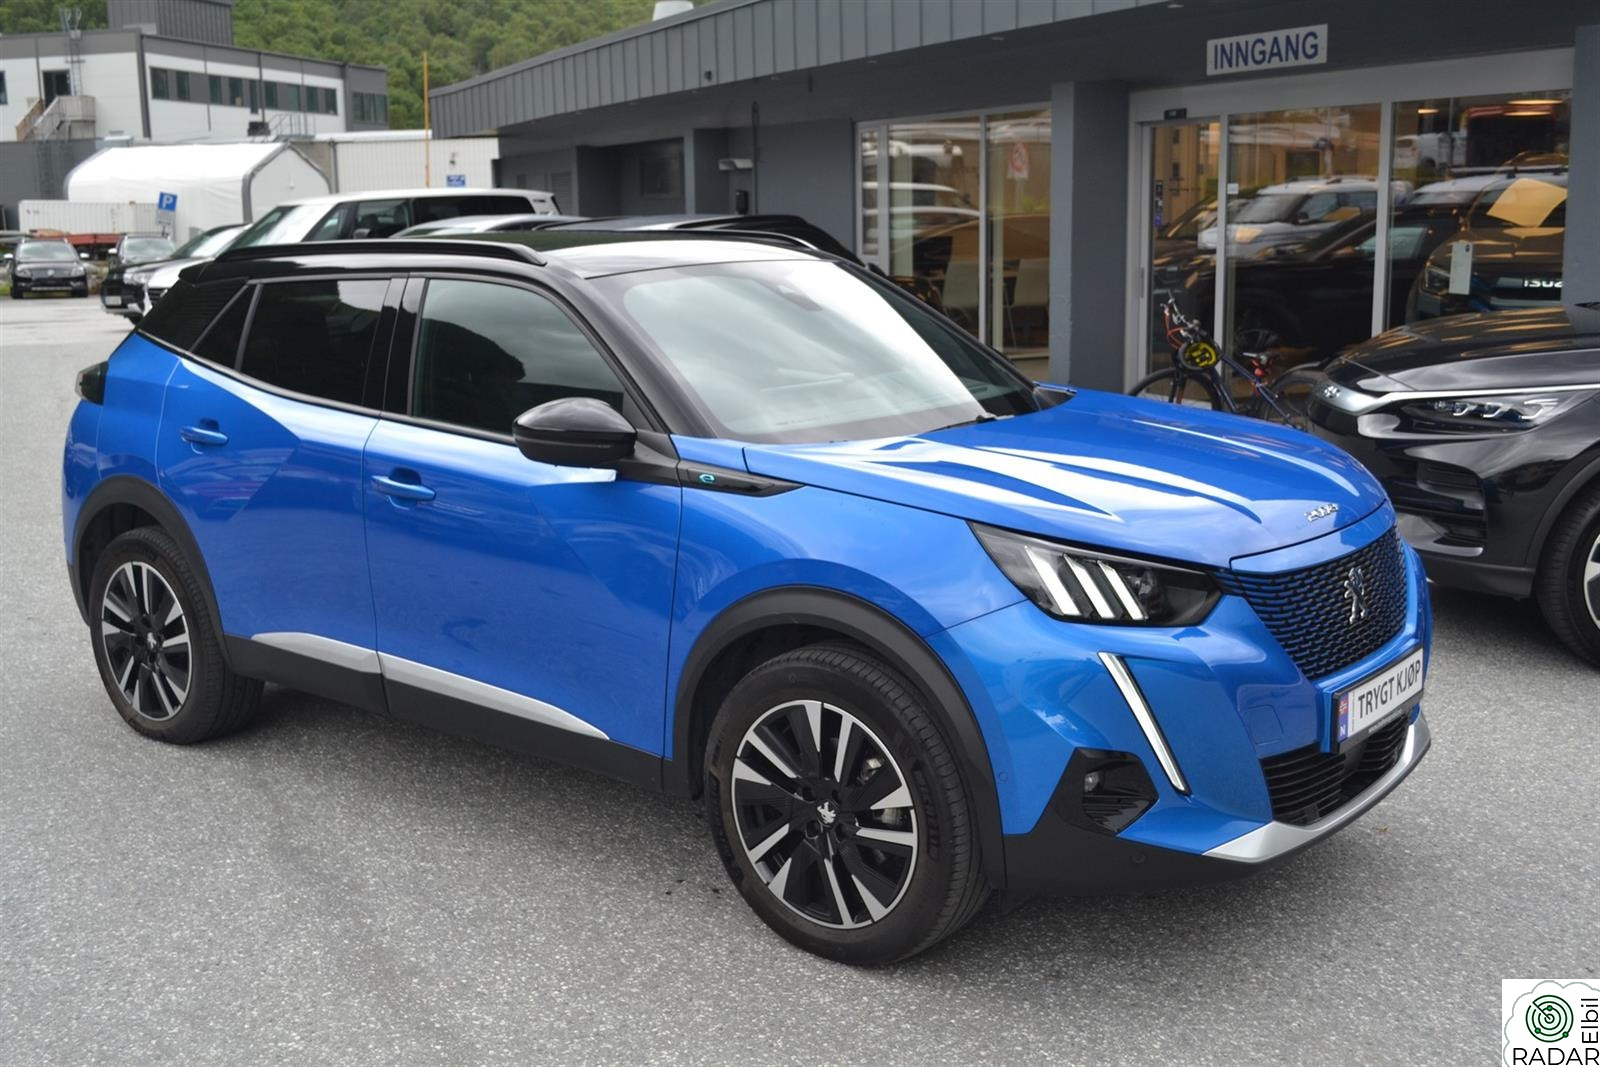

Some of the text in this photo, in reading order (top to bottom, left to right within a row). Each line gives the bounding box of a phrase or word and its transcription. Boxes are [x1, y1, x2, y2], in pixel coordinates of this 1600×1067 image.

[1214, 31, 1319, 70] INNGANG
[162, 194, 174, 209] P
[1524, 280, 1563, 288] ISUZ
[1358, 659, 1421, 719] TRYGT KJØP
[1339, 724, 1347, 737] N
